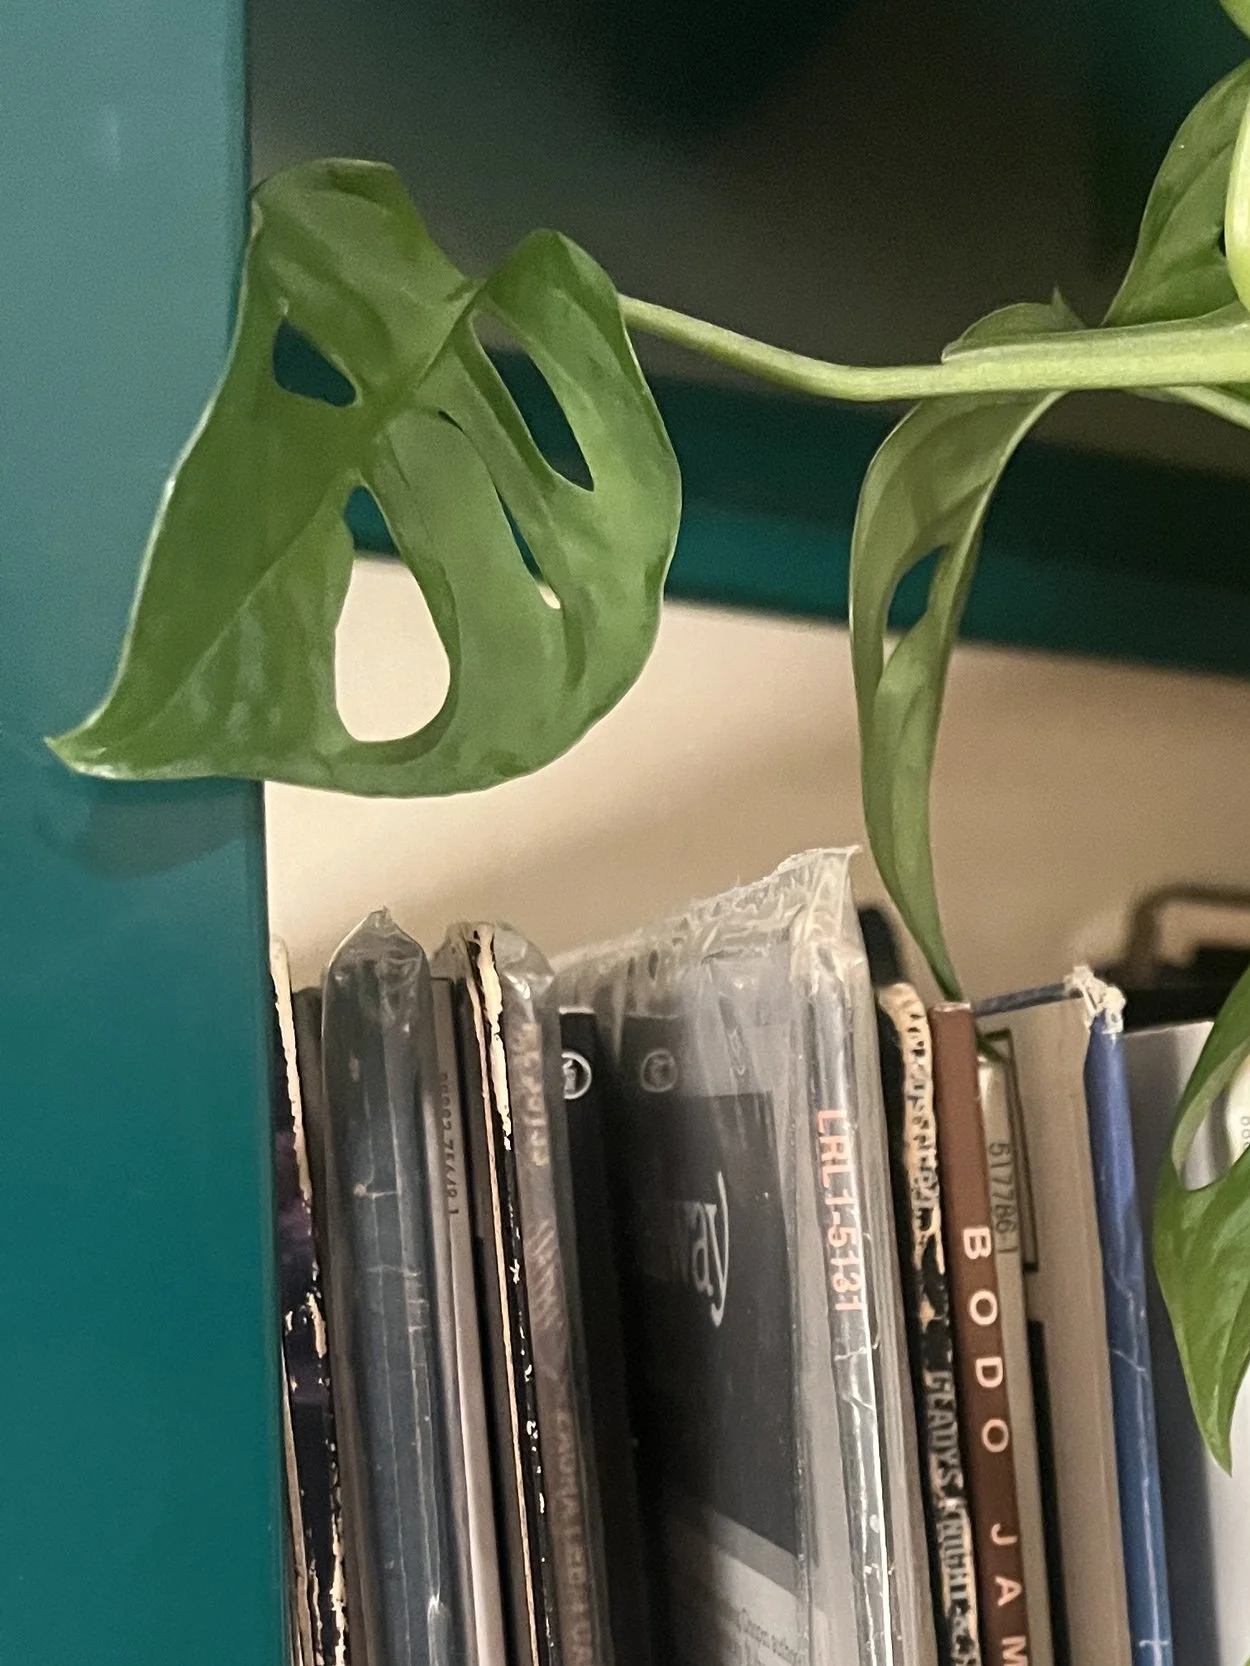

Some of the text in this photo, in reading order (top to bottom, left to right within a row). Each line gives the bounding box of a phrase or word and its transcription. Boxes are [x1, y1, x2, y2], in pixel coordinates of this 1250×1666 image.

[815, 1108, 864, 1312] LRL1-5131
[989, 1141, 1019, 1255] 517786-1
[962, 1225, 1011, 1453] BODO
